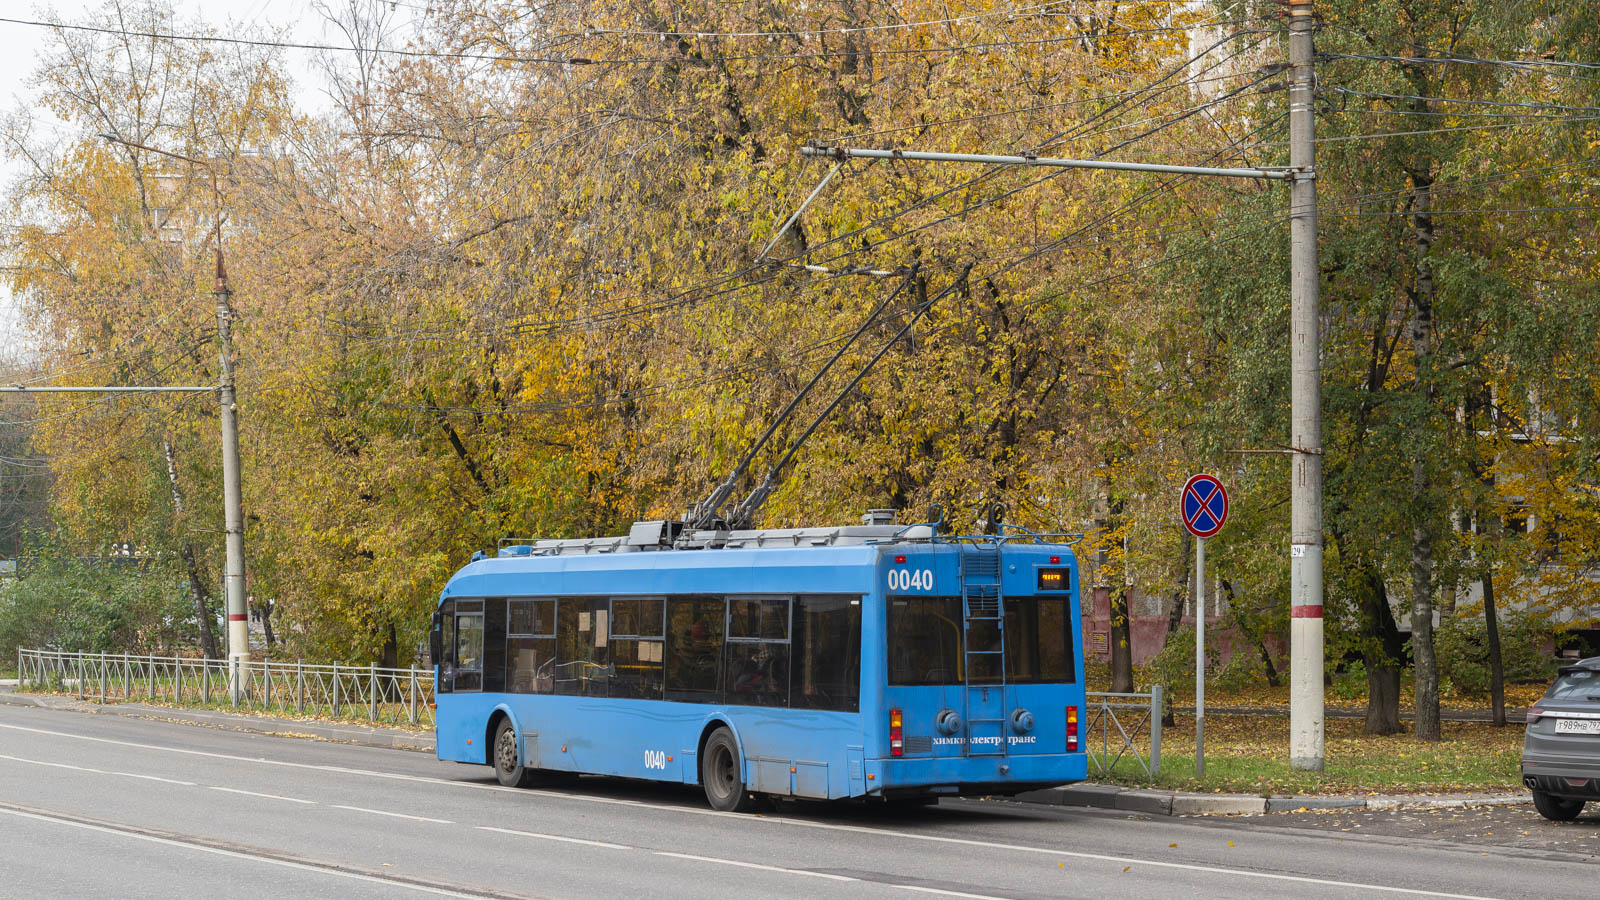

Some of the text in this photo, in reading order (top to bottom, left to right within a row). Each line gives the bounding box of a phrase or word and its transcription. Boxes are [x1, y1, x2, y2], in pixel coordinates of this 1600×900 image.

[888, 569, 933, 590] 0040
[933, 736, 1036, 746] химкилектртранс
[644, 749, 666, 770] 0040
